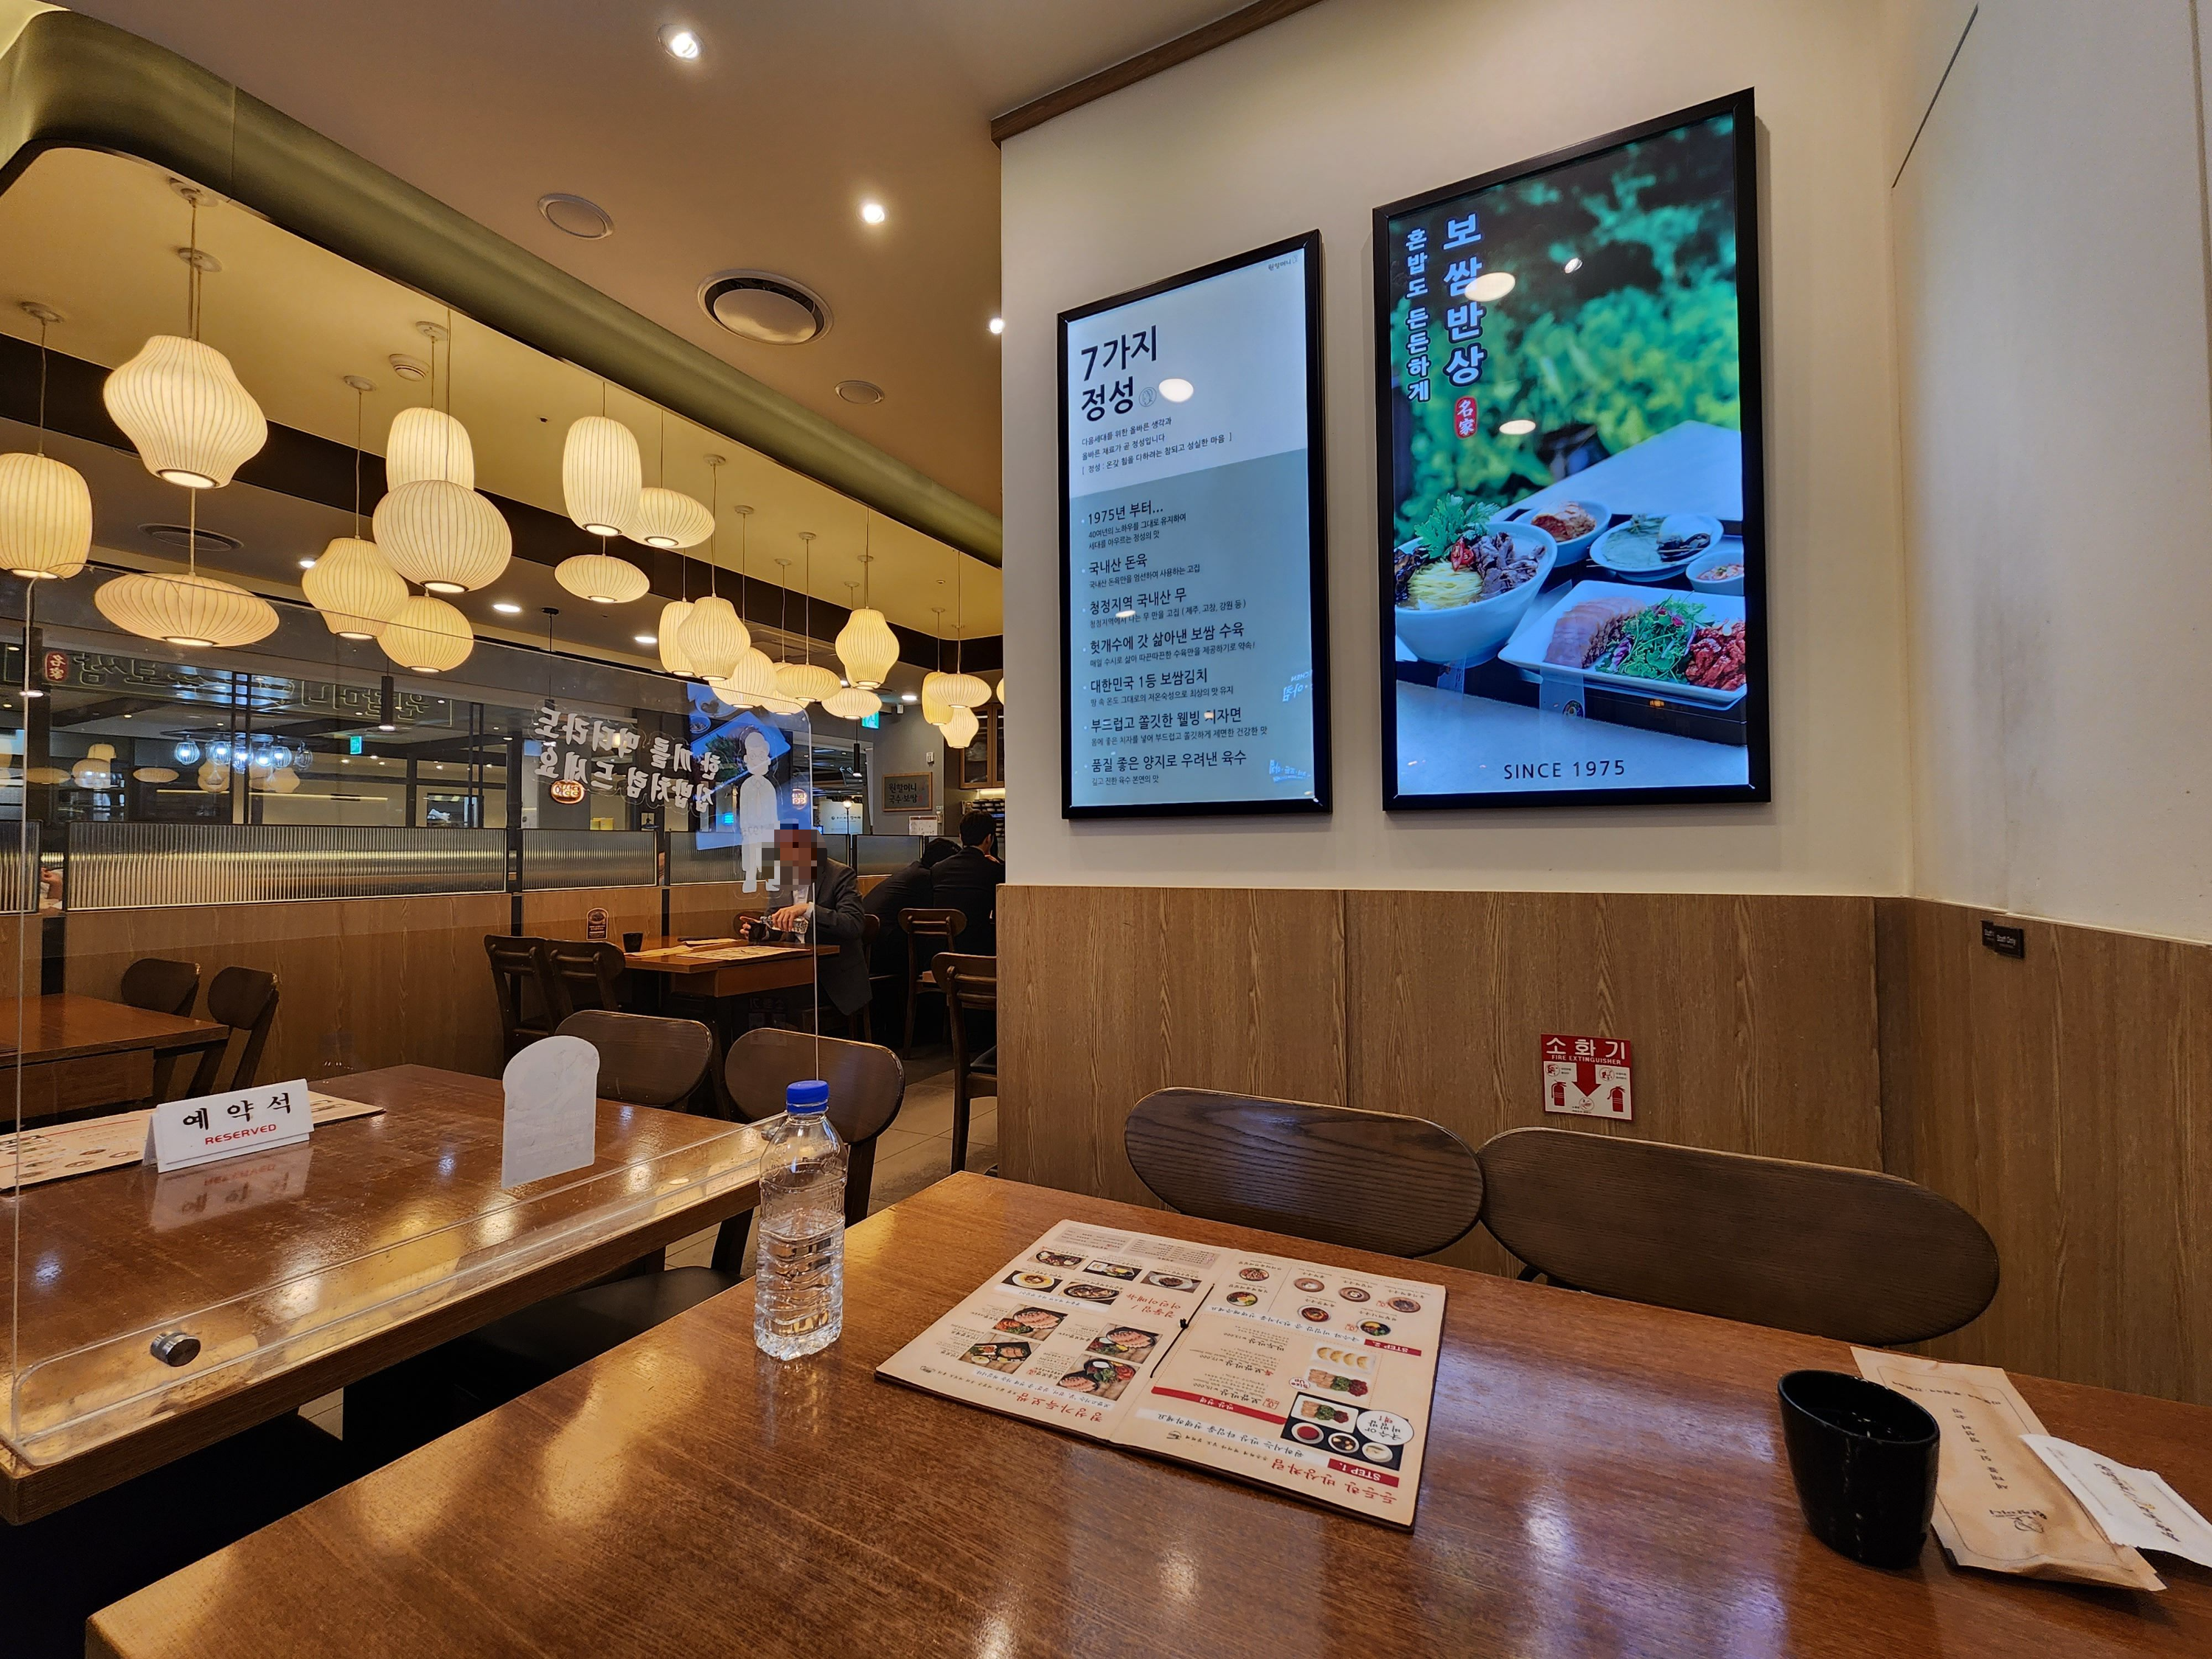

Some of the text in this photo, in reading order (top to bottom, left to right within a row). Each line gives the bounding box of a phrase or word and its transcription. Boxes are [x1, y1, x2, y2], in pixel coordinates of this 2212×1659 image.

[1443, 213, 1485, 384] 보쌈반상
[1405, 228, 1430, 402] 혼밥도 든든하게
[1081, 325, 1156, 381] 7가지
[1081, 376, 1134, 422] 정성
[1457, 399, 1475, 437] 名家
[1082, 417, 1172, 446] 다음세대를 위한 올바른 생각과
[1082, 433, 1165, 461] 올바른 재료가 곧 정성입니다
[1088, 434, 1225, 473] 정성 온갖 힘을 다하려는 참되고 성실한 마음
[1088, 500, 1164, 526] 1975년 부터...
[1088, 512, 1186, 539] 40여년의 노하우를 그대로 유지하여
[1088, 530, 1160, 550] 세대를 아우르는 정성의 맛
[1088, 553, 1148, 576] 국내산 돈육
[1089, 564, 1200, 589] 국내산 돈육만을 엄선하여 사용하는 고집
[1090, 588, 1186, 616] 청정지역 국내산 무
[1166, 606, 1180, 618] 고집
[1219, 600, 1233, 611] 강원
[1091, 622, 1244, 656] 헛개수에 갓 삶아낸 보쌈 수육
[1091, 658, 1102, 668] 매일
[1104, 656, 1123, 666] 수시로
[1124, 654, 1137, 664] 삶아
[1139, 650, 1172, 663] 따끈따끈한
[1174, 647, 1200, 659] 수육만을
[1203, 643, 1237, 655] 제공하기로
[1091, 667, 1208, 693] 대한민국 1등 보쌈김치
[1107, 696, 1119, 705] 온도
[1121, 693, 1147, 704] 그대로의
[1148, 690, 1187, 703] 저온숙성으로
[1189, 686, 1210, 698] 최상의
[1211, 686, 1218, 696] 맛
[1220, 686, 1234, 695] 유지
[1091, 714, 1135, 733] 부드럽고
[1138, 712, 1173, 728] 쫄깃한
[1177, 710, 1200, 726] 웰빙
[1119, 735, 1139, 745] 치자를
[1155, 731, 1181, 743] 부드럽고
[1183, 729, 1211, 740] 쫄깃하게
[1213, 728, 1234, 738] 제면한
[1237, 726, 1258, 737] 건강한
[1260, 726, 1267, 736] 맛
[1091, 749, 1247, 773] 품질 좋은 양지로 우려낸 육수
[1504, 760, 1624, 779] SINCE 1975
[889, 783, 917, 793] 원할머니
[1105, 776, 1117, 785] 진한
[1119, 776, 1131, 785] 육수
[1132, 774, 1152, 784] 본연의
[1152, 774, 1159, 784] 맛
[1546, 1037, 1625, 1060] 소화기
[1569, 1055, 1621, 1065] EXTINGUISHER
[183, 1092, 291, 1130] 예약석
[205, 1124, 276, 1144] RESERVED
[1382, 1343, 1410, 1352] STEP
[1270, 1458, 1397, 1504] 든든한 반상차림
[1349, 1466, 1382, 1481] STEP
